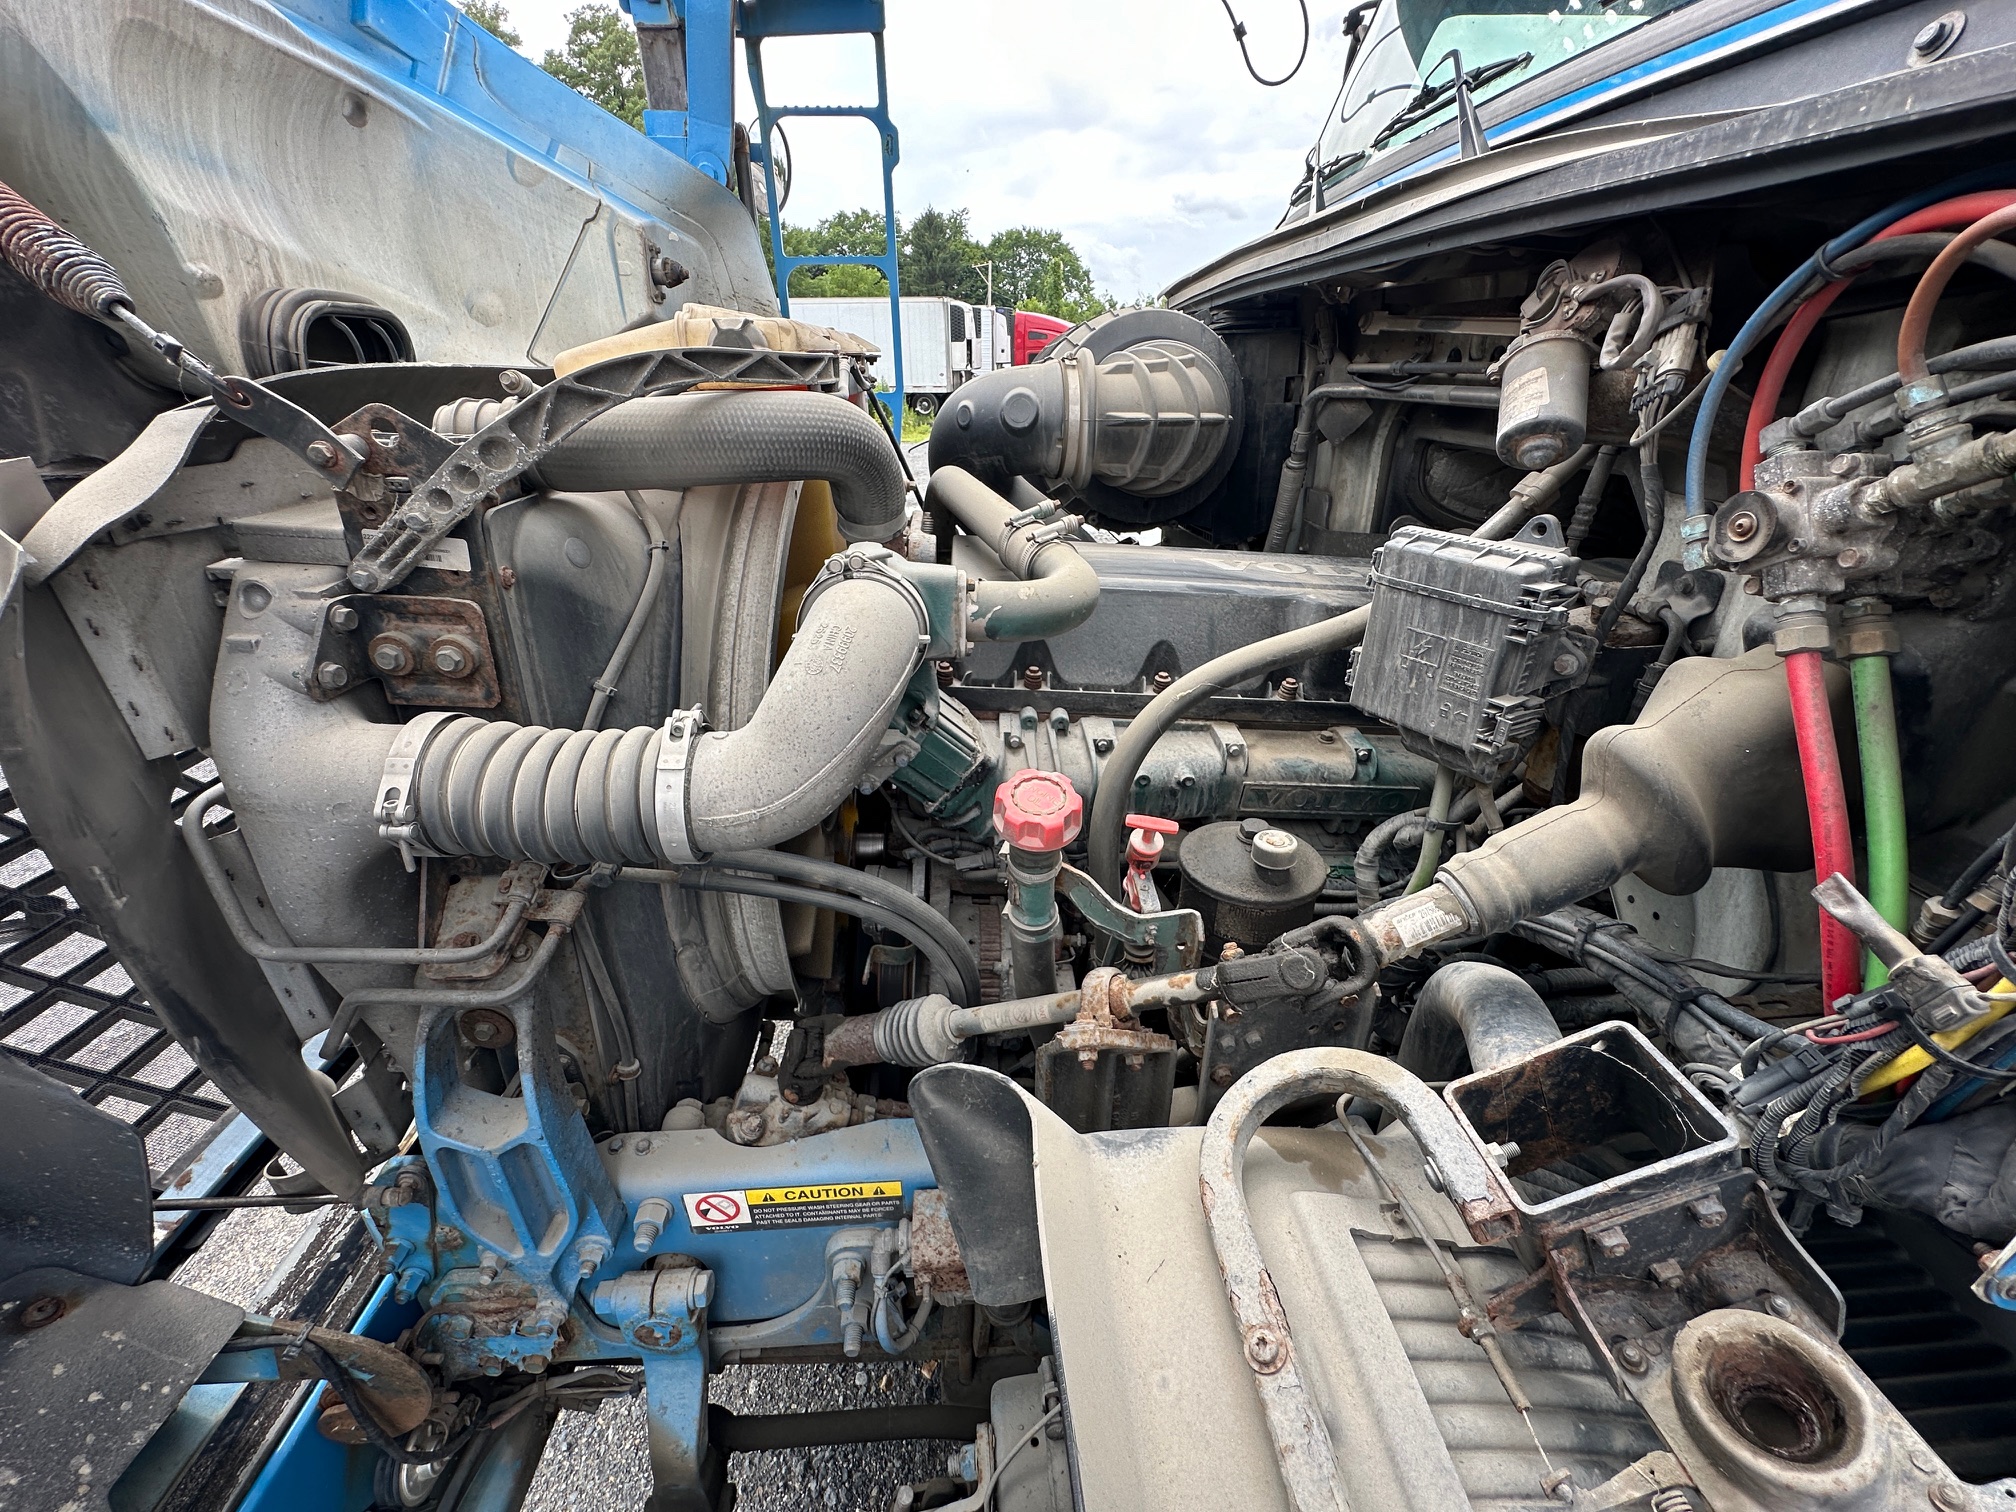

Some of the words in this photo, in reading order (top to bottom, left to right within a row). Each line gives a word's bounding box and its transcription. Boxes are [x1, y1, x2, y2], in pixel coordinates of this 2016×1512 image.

[823, 624, 842, 651] CHINA
[830, 625, 858, 674] 20999337
[1022, 783, 1062, 806] ENGINE
[1027, 794, 1041, 807] OIL
[1250, 788, 1411, 809] VOLVO
[1229, 905, 1262, 919] POWER
[784, 1187, 863, 1200] CAUTION
[803, 1208, 848, 1217] CONTAMINANTS
[803, 1215, 834, 1223] DAMAGING
